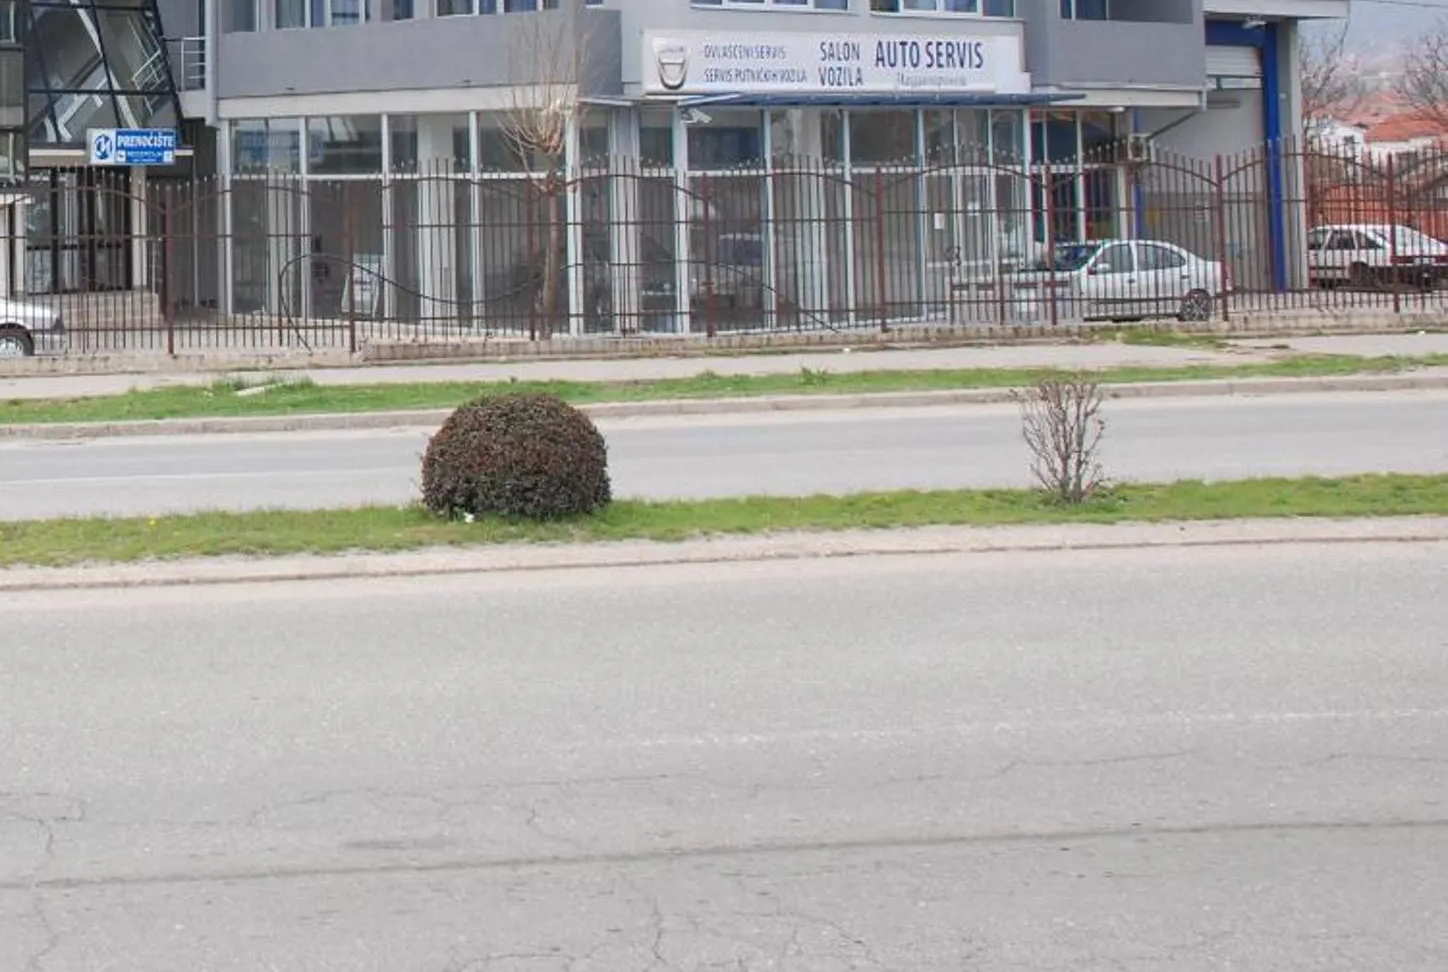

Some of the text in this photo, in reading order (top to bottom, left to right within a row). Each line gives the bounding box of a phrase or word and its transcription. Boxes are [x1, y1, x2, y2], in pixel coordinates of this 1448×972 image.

[753, 44, 787, 59] SERVIS
[820, 41, 860, 61] SALON
[875, 40, 984, 69] AUTO SERVIS
[704, 67, 733, 82] SERVIS
[818, 66, 864, 87] VOZILA
